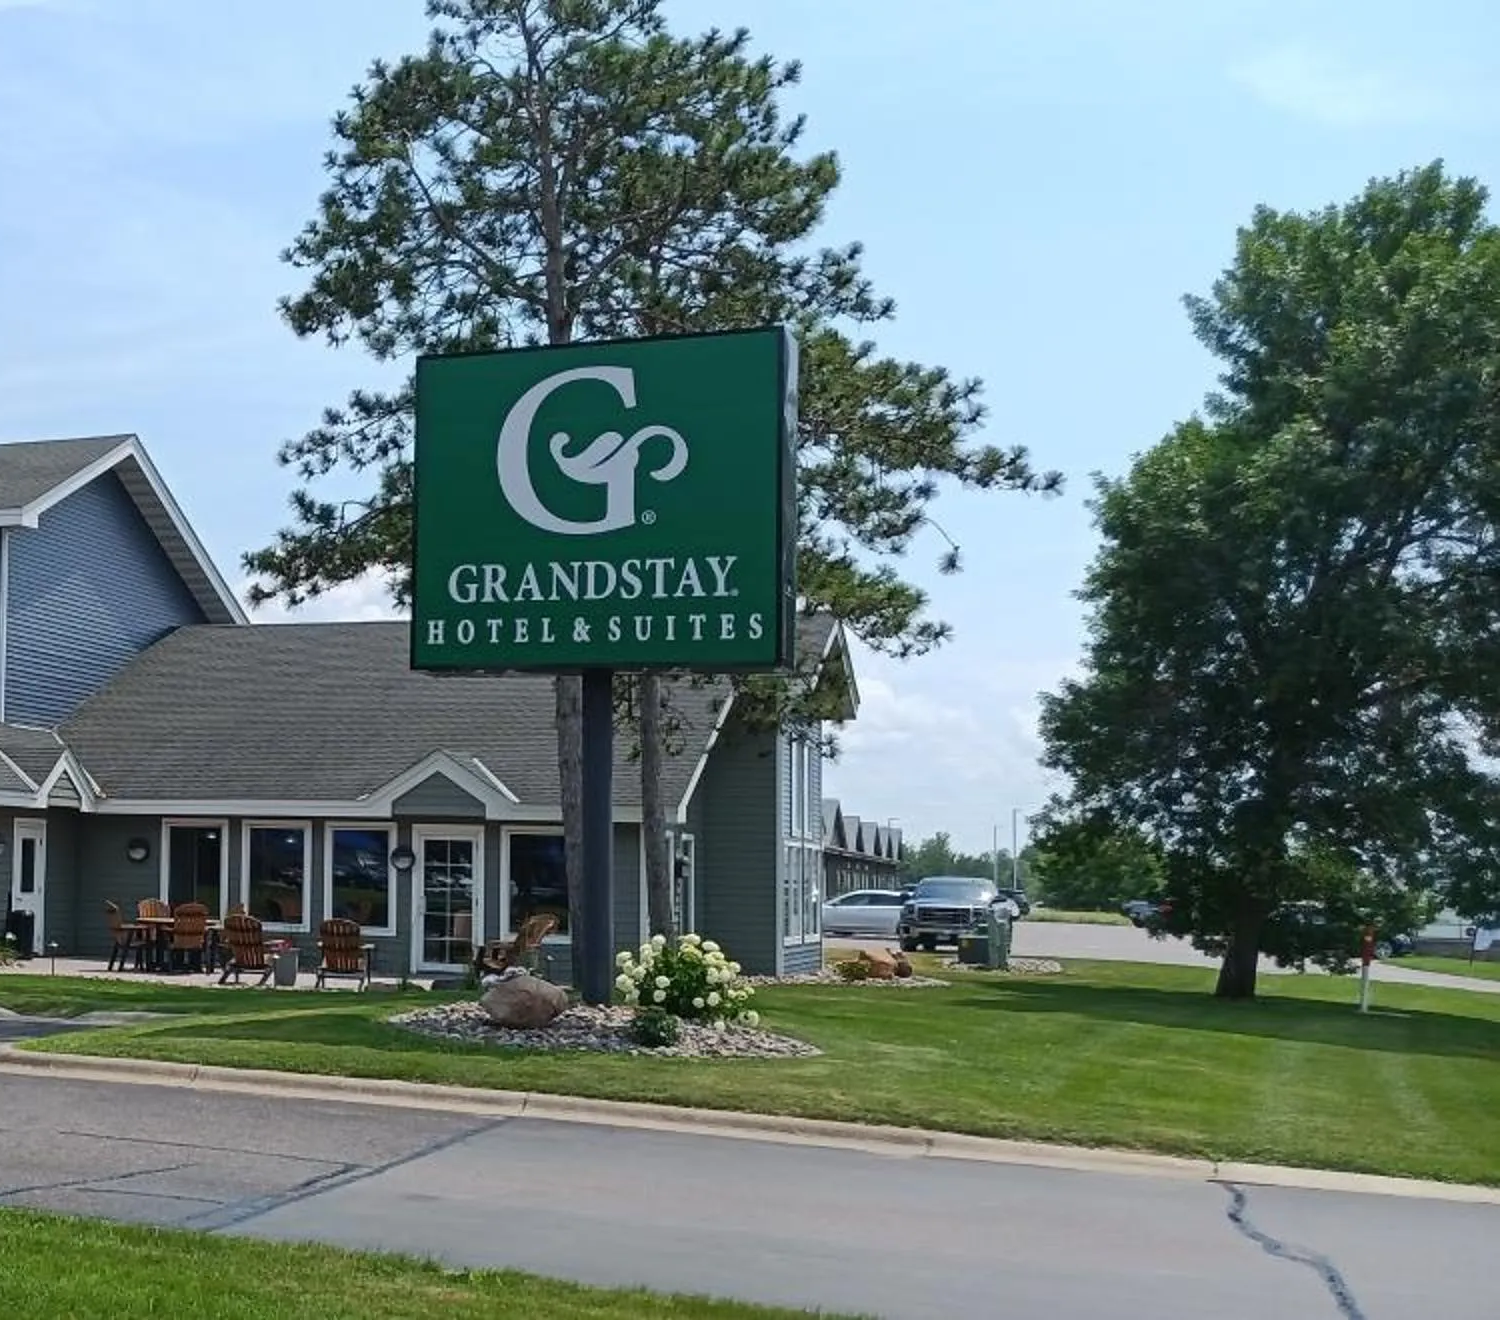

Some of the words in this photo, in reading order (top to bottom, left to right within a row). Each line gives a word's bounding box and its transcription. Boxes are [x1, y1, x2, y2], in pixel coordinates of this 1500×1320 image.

[448, 556, 739, 603] GRANDSTAY
[427, 617, 555, 645] HOTEL
[572, 616, 592, 643] &
[608, 612, 764, 642] SUITES
